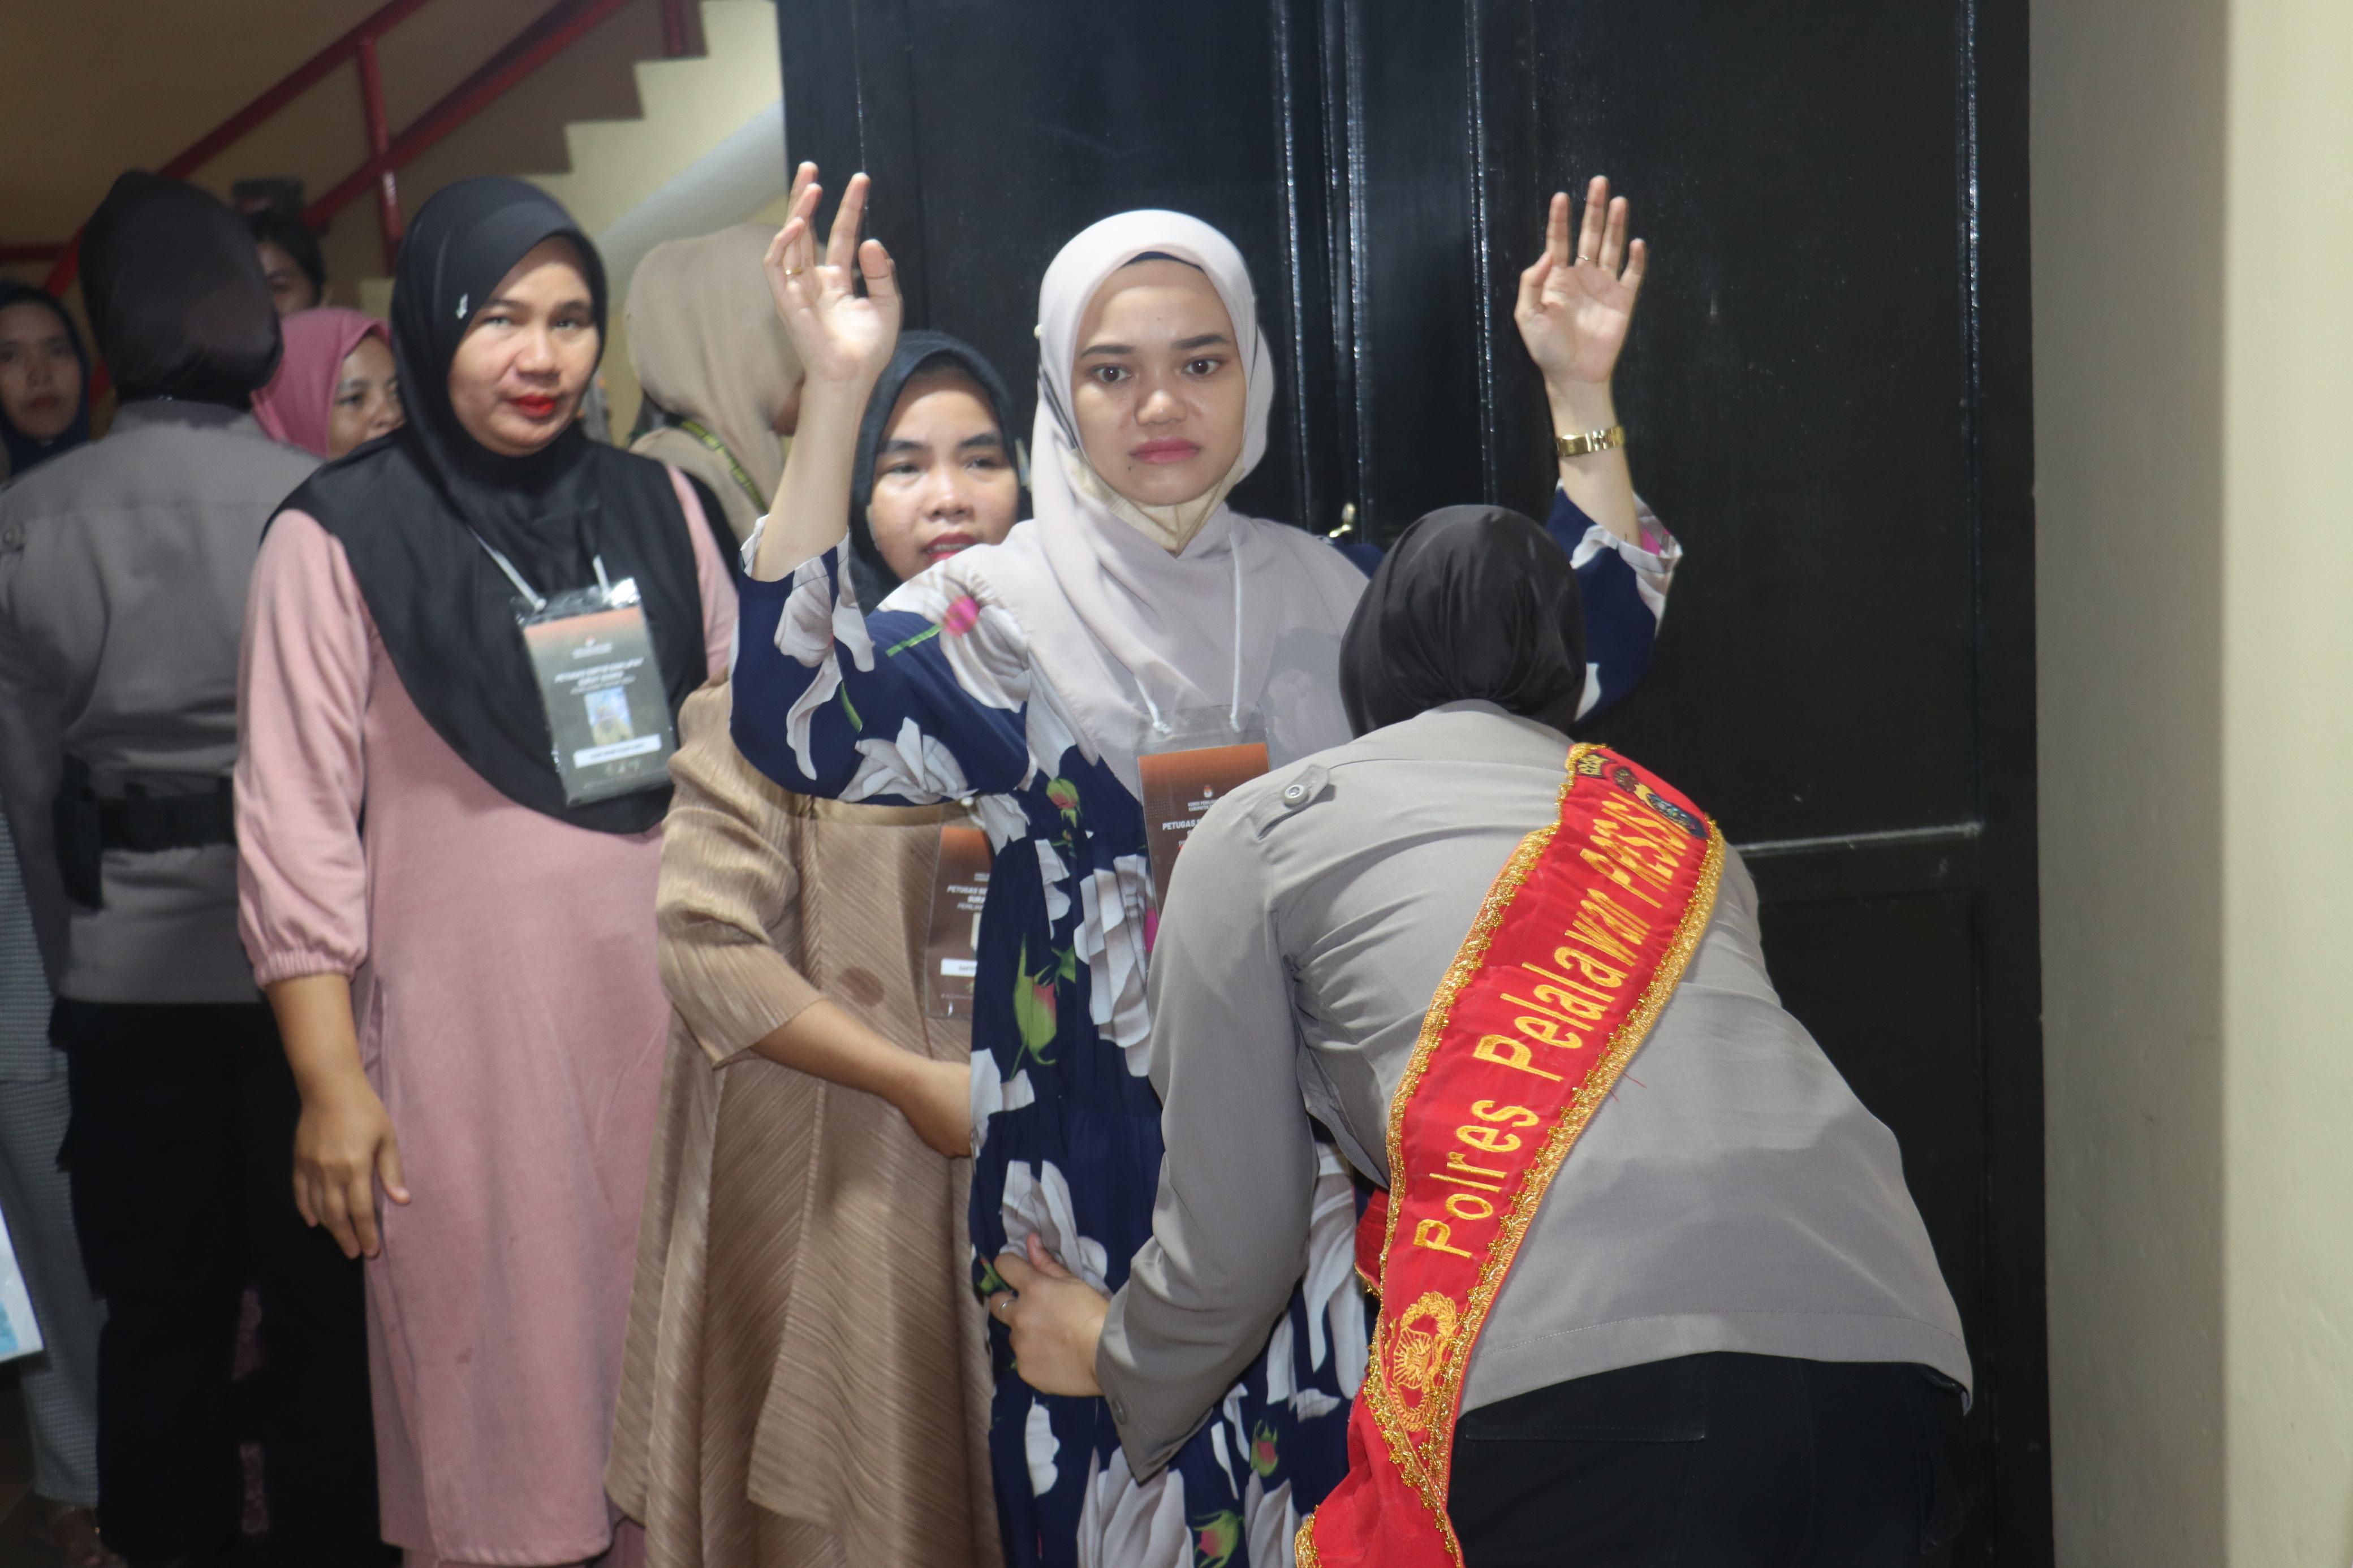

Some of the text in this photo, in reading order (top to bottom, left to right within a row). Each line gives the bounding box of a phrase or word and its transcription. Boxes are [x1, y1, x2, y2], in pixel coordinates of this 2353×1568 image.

[1162, 819, 1196, 831] PETUGAS
[1413, 791, 1692, 1258] Polres Pelalawan PRESISI
